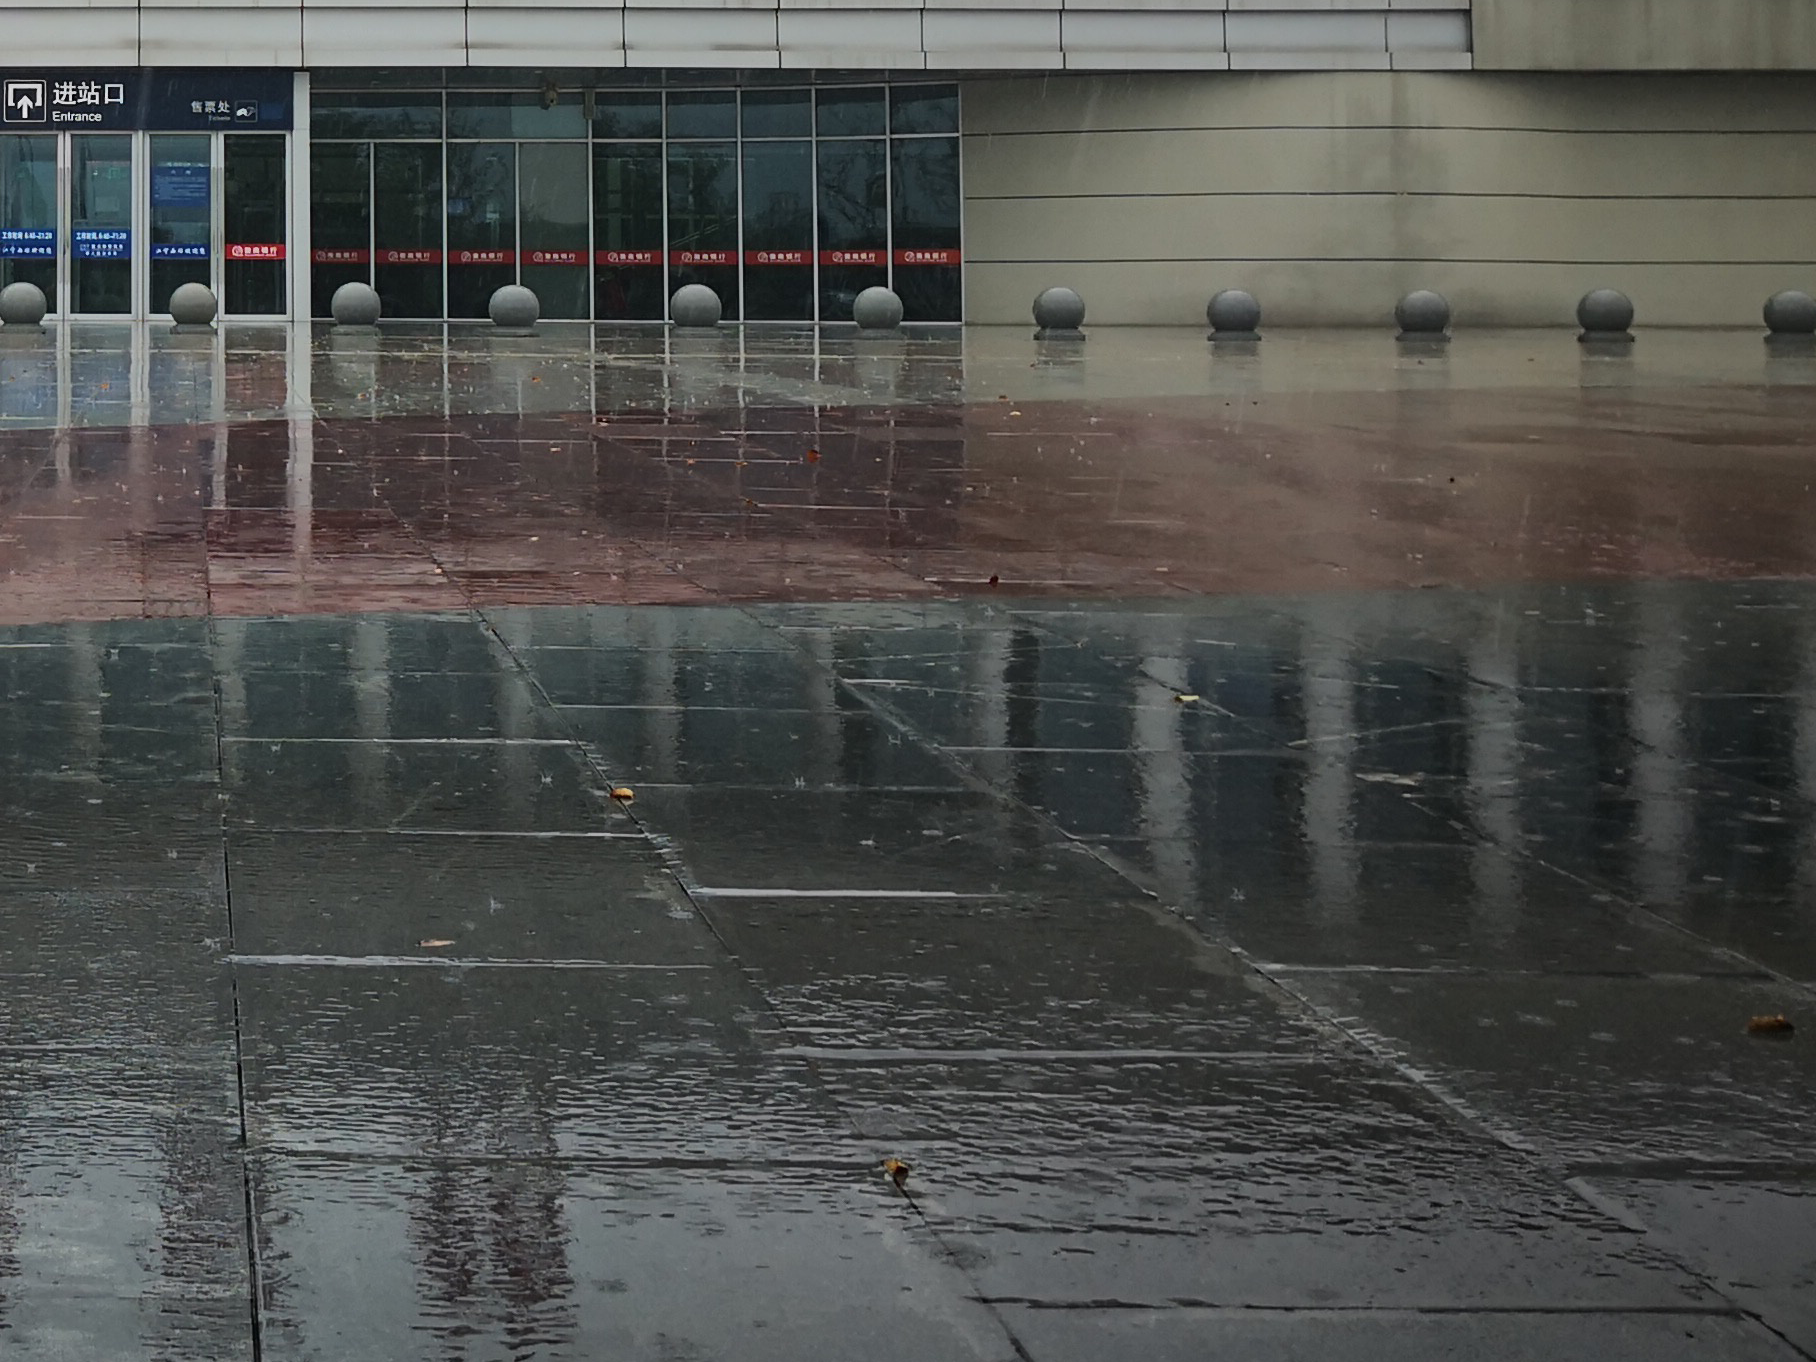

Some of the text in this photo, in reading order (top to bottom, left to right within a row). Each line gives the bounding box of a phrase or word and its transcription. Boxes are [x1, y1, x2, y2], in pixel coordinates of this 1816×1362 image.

[52, 81, 124, 105] 进站口
[190, 100, 231, 114] 售票处
[52, 111, 102, 122] Entrance
